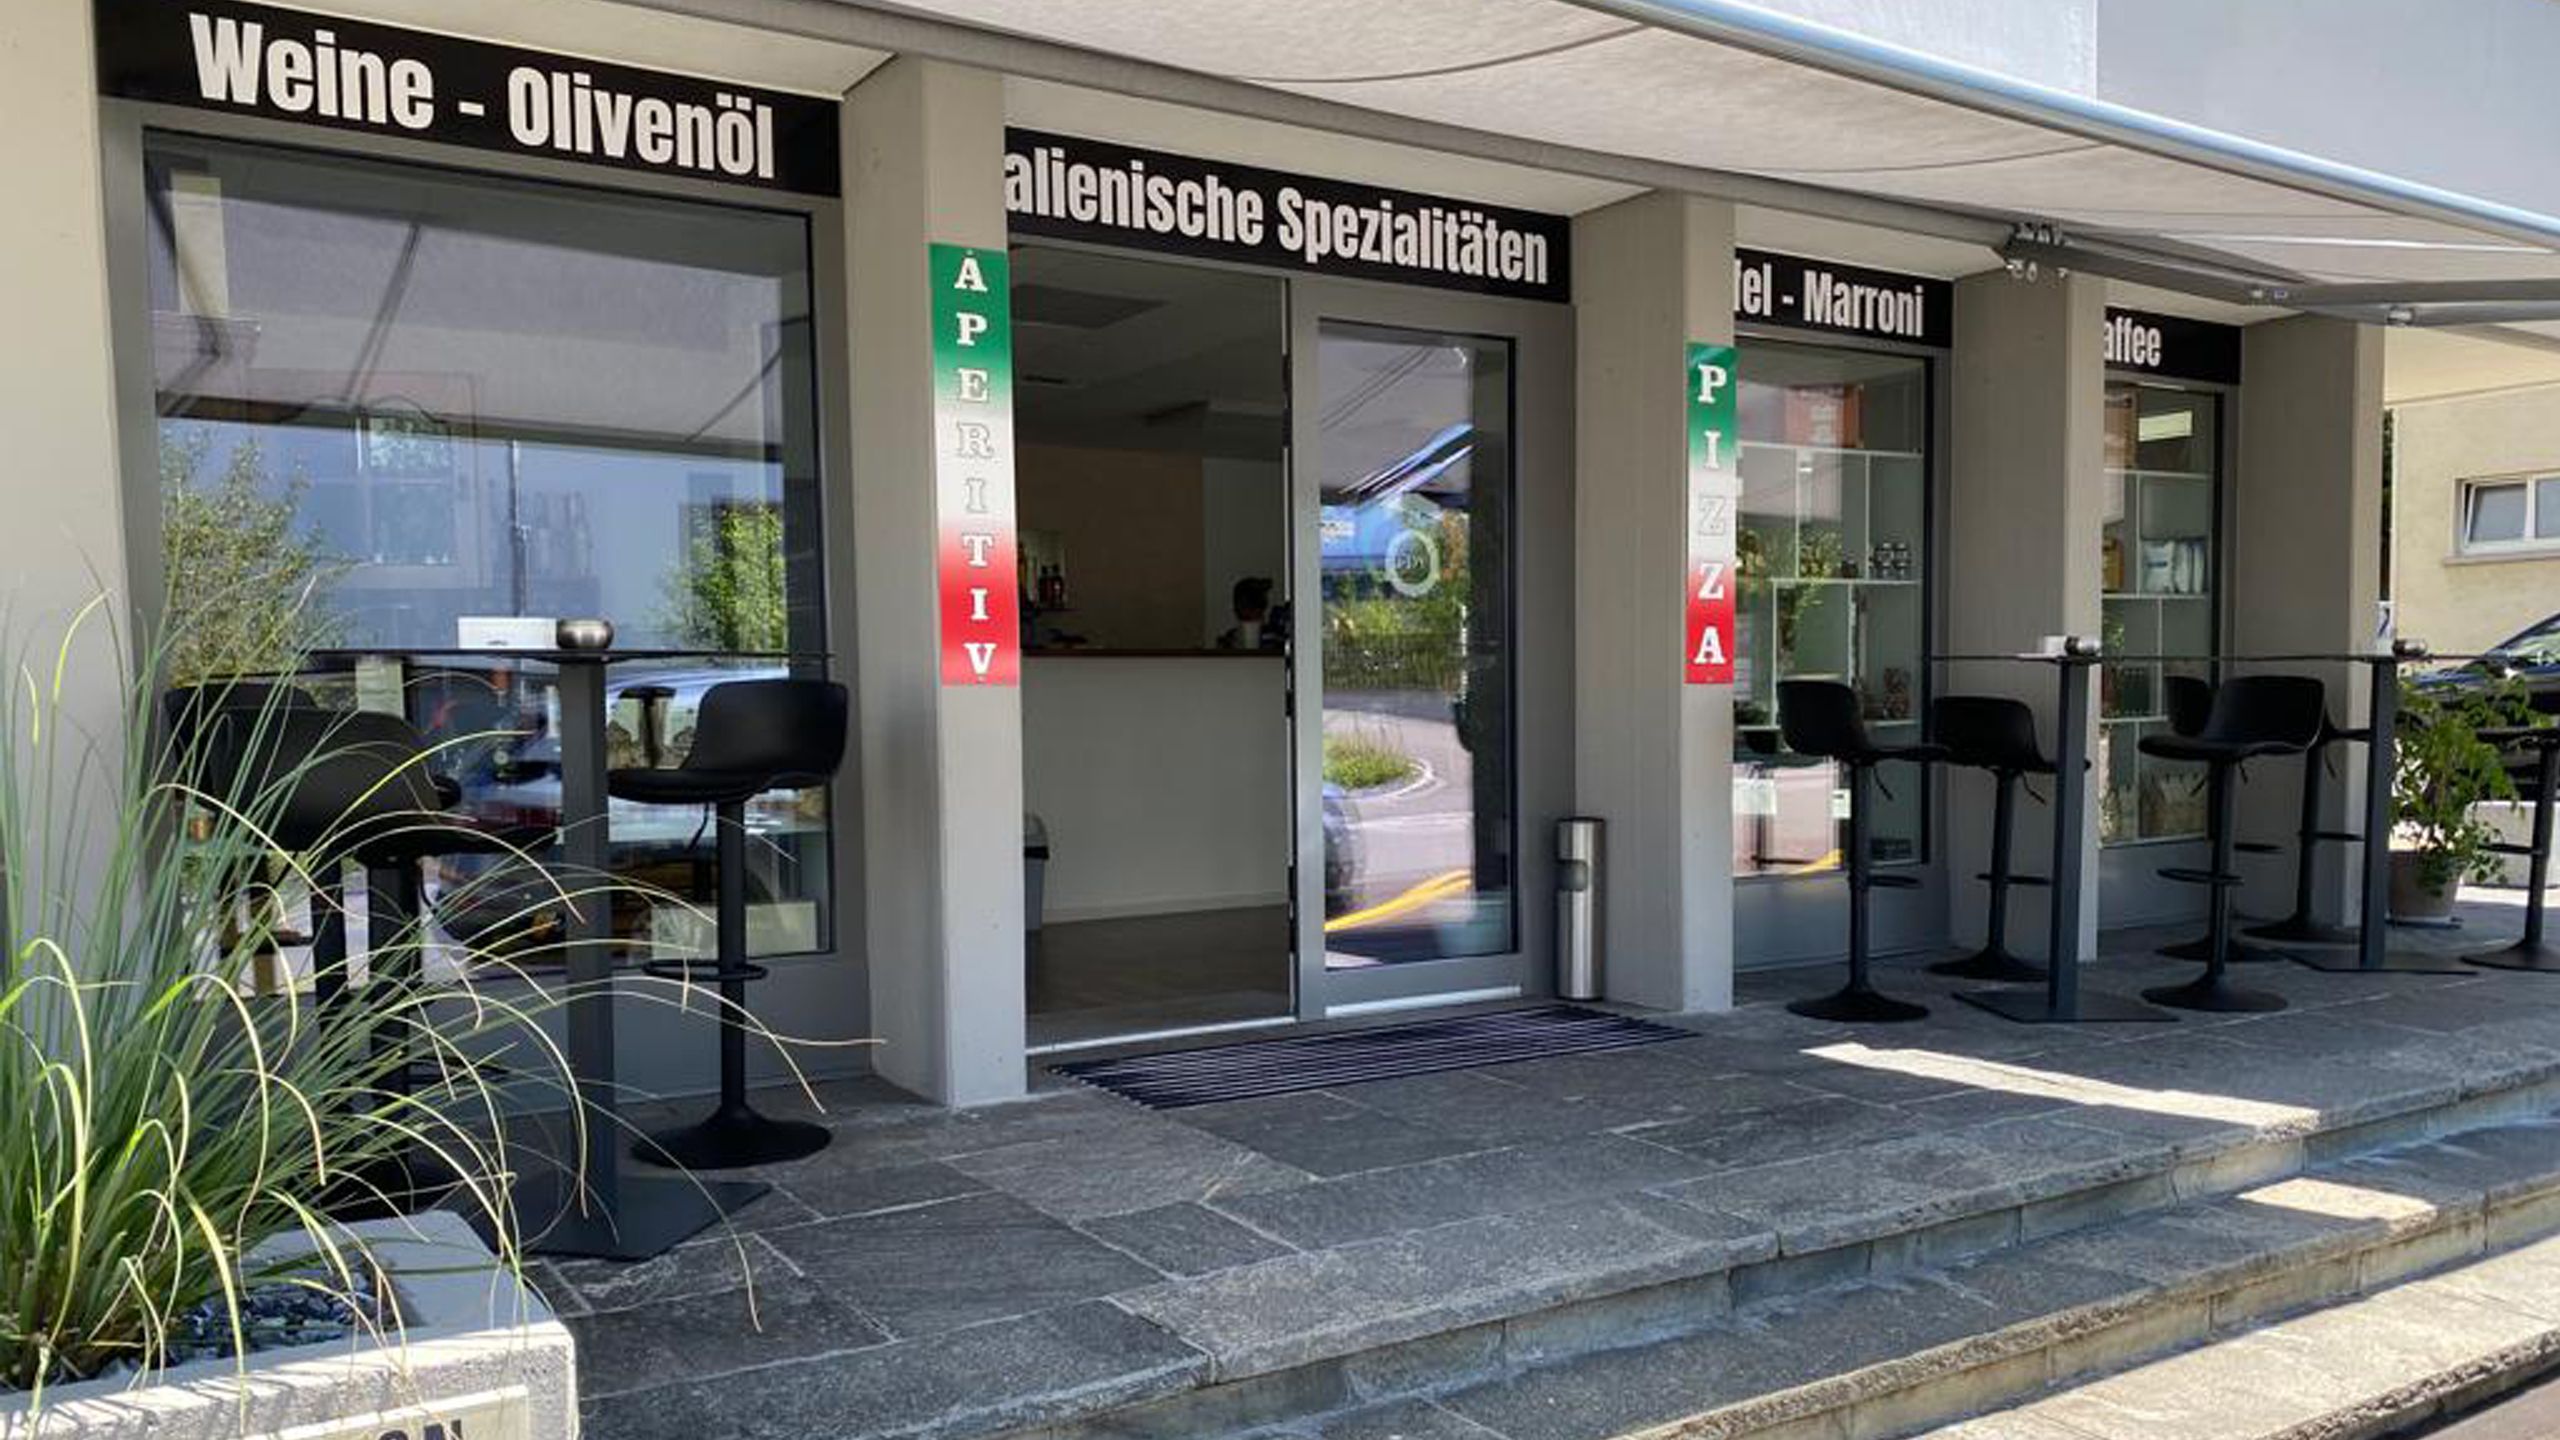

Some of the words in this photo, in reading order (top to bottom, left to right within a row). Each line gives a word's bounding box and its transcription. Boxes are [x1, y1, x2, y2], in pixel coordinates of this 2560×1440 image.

[189, 13, 434, 130] Weine
[458, 101, 485, 116] -
[508, 67, 774, 179] Olivenöl
[1005, 147, 1264, 245] alienische
[1278, 187, 1548, 285] Spezialitäten
[1782, 295, 1794, 305] -
[1803, 268, 1923, 337] Marroni
[2104, 316, 2161, 367] affee
[1693, 362, 1728, 666] PIZZA
